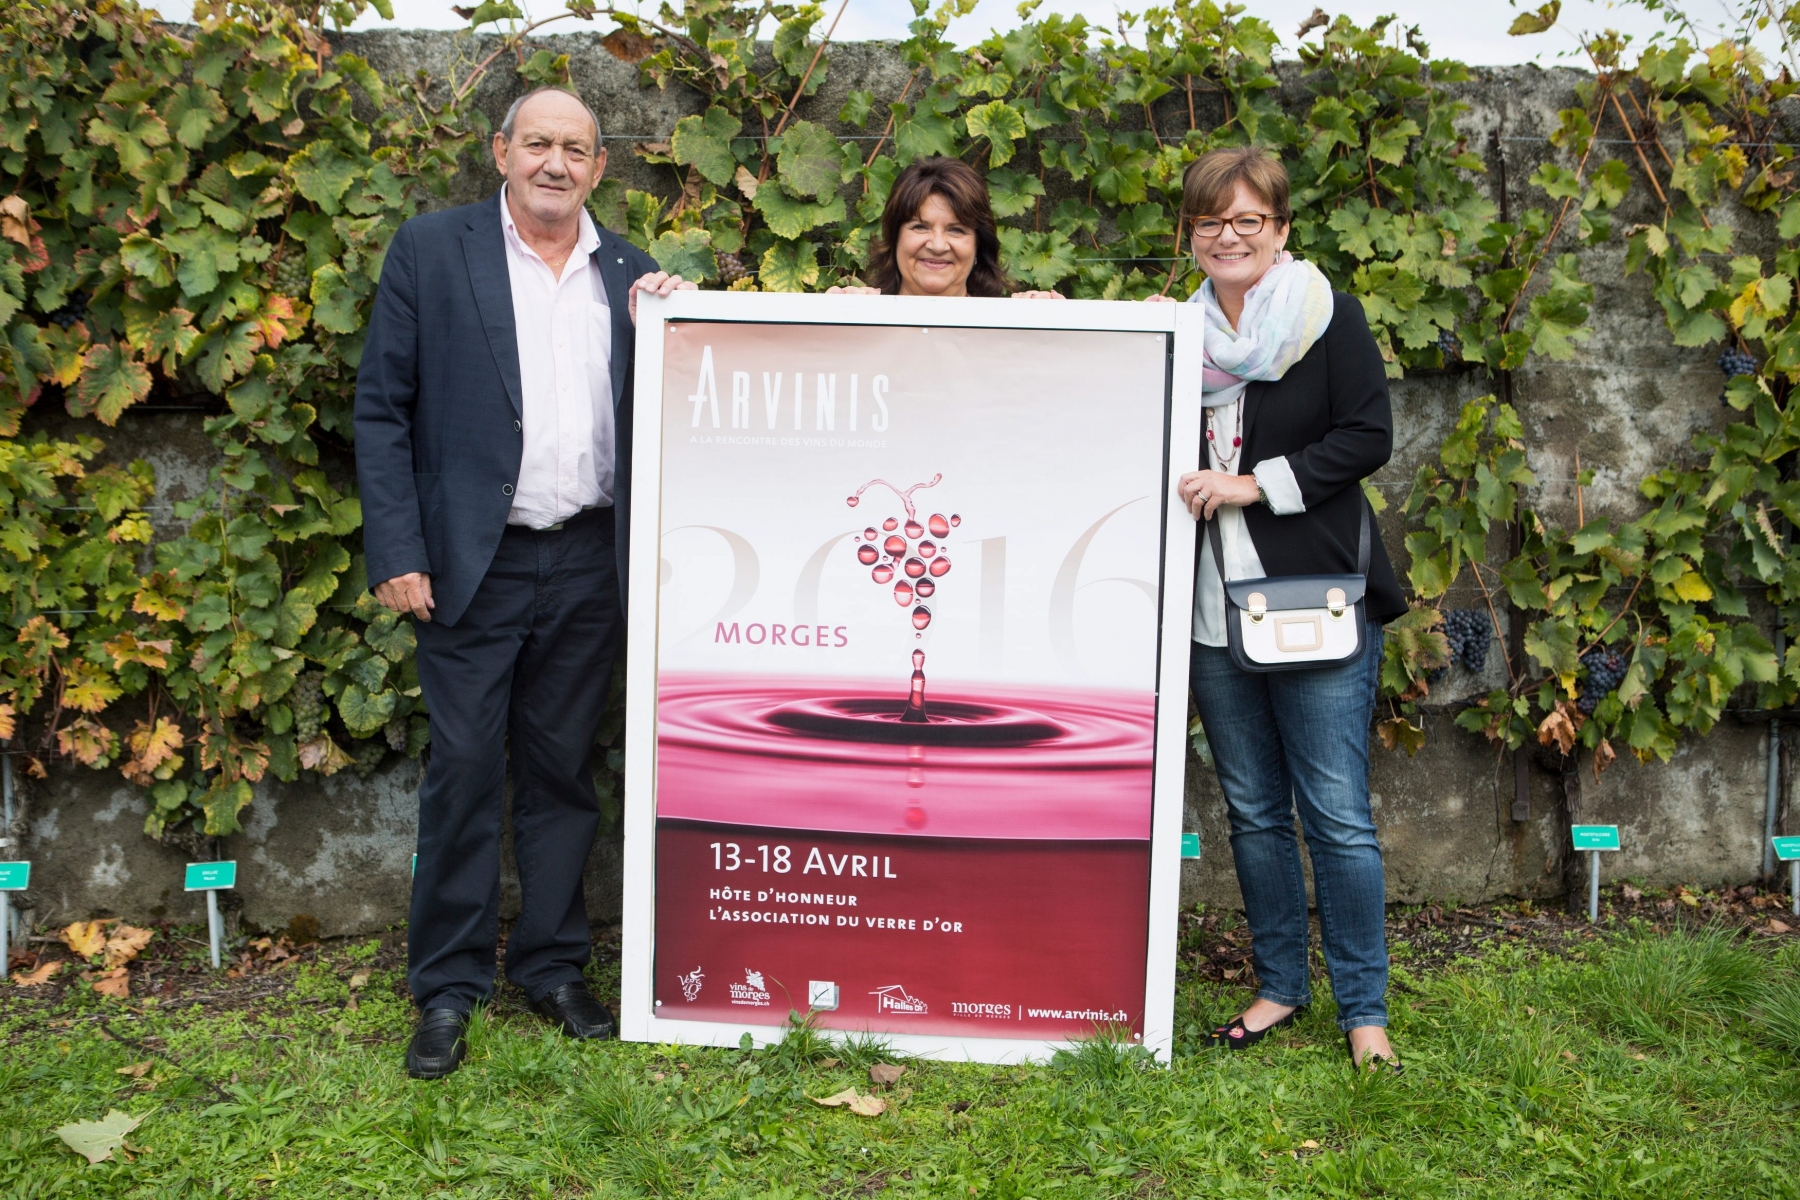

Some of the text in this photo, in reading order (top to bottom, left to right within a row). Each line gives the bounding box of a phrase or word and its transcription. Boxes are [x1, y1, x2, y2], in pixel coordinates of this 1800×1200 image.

[690, 435, 888, 448] A LA RENCONTRE DES VINS DU MONDE
[714, 622, 849, 648] MORGES
[710, 842, 792, 874] 13-18
[709, 886, 858, 906] HÔTE D'HONNEUR
[709, 906, 963, 933] L'ASSOCIATION DU VERRE D'OR
[729, 983, 747, 991] vins
[729, 990, 770, 1002] morges
[883, 996, 914, 1011] Halles
[951, 1002, 1011, 1015] morges
[1027, 1008, 1128, 1021] www.arvinis.ch
